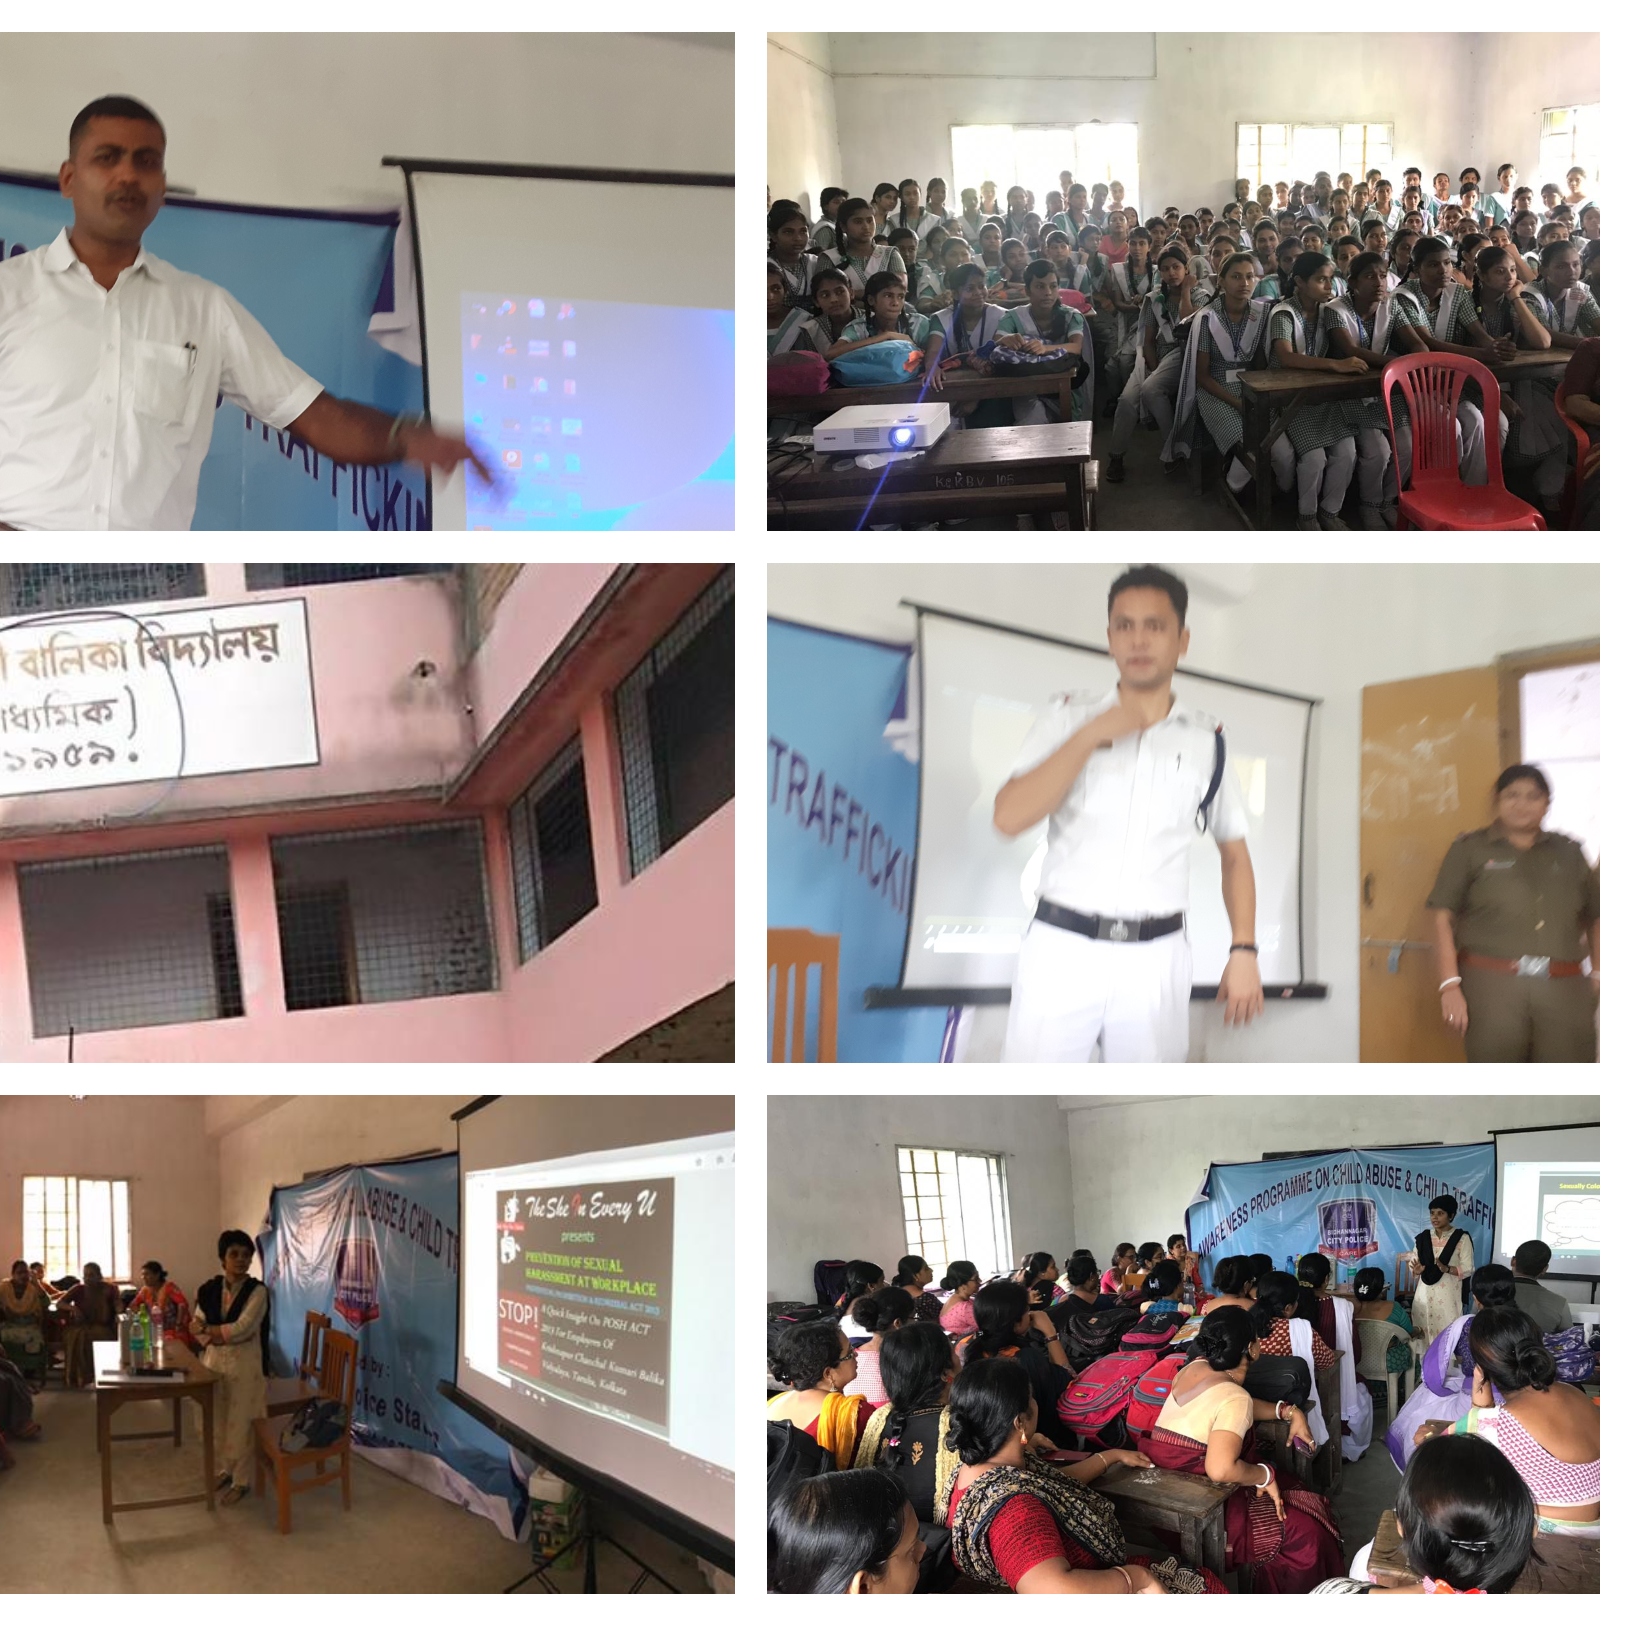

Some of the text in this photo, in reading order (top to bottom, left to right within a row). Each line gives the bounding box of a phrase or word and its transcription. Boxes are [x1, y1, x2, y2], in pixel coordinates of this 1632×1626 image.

[19, 630, 128, 679] বালিকা
[1559, 1182, 1585, 1190] Sexually
[525, 1194, 545, 1217] The
[546, 1195, 569, 1218] She
[589, 1191, 633, 1223] Every
[636, 1189, 657, 1217] U
[1197, 1202, 1249, 1260] AWARENESS
[1250, 1170, 1313, 1218] PROGRAMME
[1315, 1167, 1330, 1190] ON
[1332, 1162, 1363, 1187] CHILD
[1365, 1162, 1402, 1191] ABUSE
[1404, 1173, 1413, 1192] &
[1415, 1174, 1449, 1198] CHILD
[409, 1202, 442, 1259] CHILD
[560, 1231, 596, 1243] presents
[1327, 1235, 1369, 1245] CITY POLICE
[571, 1256, 582, 1268] OF
[583, 1257, 624, 1274] SEXUAL
[577, 1275, 590, 1288] AT
[591, 1275, 657, 1297] WORKPLACE
[499, 1299, 538, 1329] STOP!
[547, 1304, 565, 1318] Quick
[588, 1313, 601, 1326] On
[602, 1316, 628, 1331] POSH
[628, 1321, 652, 1336] ACT
[602, 1338, 616, 1350] Of
[371, 1356, 384, 1378] by
[574, 1352, 608, 1370] Chanchal
[608, 1360, 638, 1378] Kumari
[638, 1369, 665, 1387] Balika
[599, 1378, 627, 1397] Kolkata
